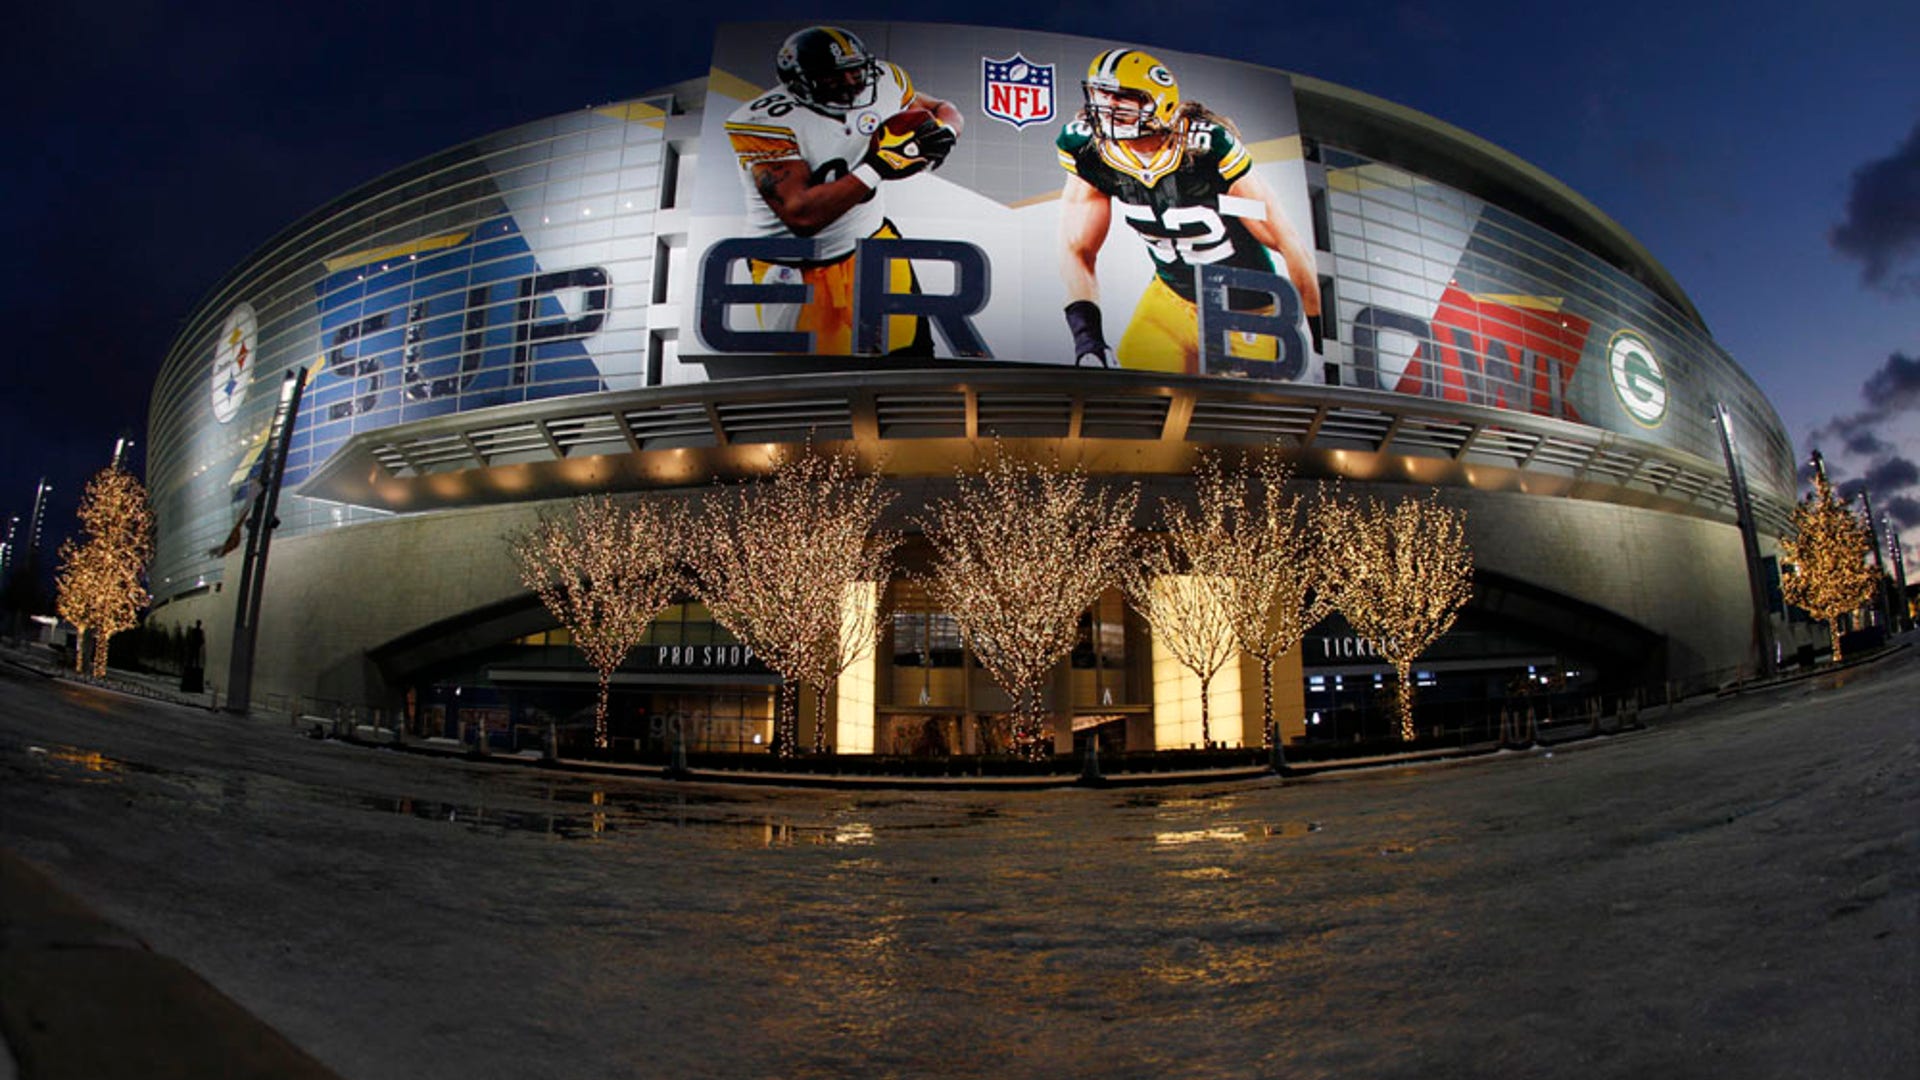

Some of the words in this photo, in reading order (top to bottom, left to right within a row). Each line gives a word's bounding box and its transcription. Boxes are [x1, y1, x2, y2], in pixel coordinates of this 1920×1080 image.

[991, 84, 1048, 119] NFL
[1611, 337, 1667, 420] G
[659, 645, 694, 666] PRO
[703, 645, 754, 666] SHOP
